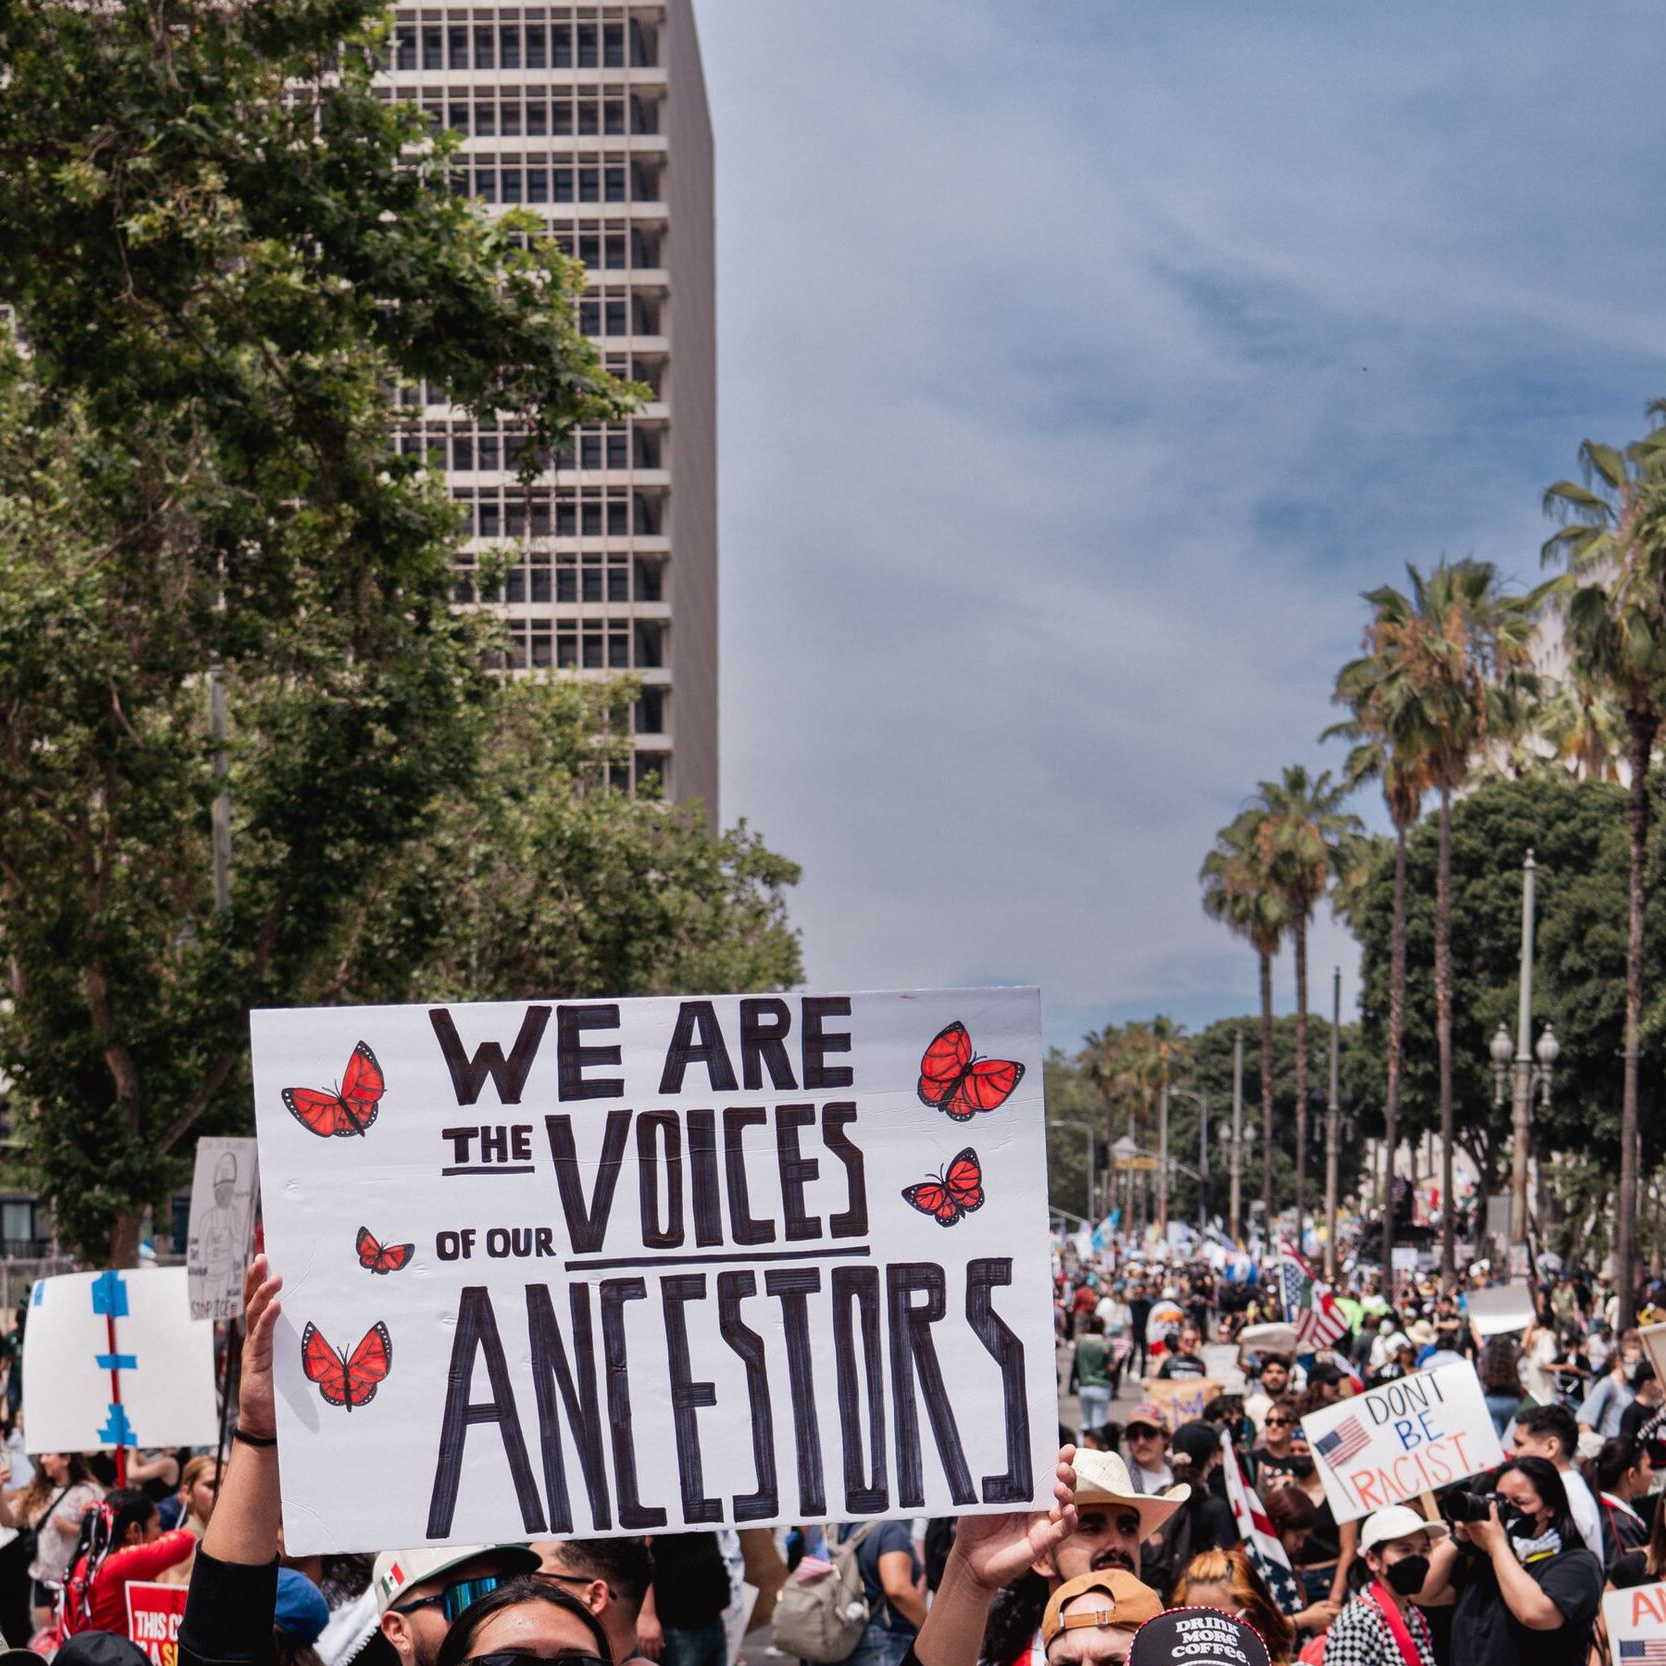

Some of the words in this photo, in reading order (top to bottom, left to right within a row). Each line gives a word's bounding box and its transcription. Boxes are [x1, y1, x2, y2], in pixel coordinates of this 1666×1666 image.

[428, 1005, 625, 1105] WE
[659, 997, 854, 1093] ARE
[442, 1124, 534, 1165] THE
[545, 1101, 868, 1253] VOICES
[435, 1229, 477, 1261] OF
[486, 1226, 555, 1258] OUR
[426, 1257, 1035, 1539] ANCESTORS
[1394, 1410, 1446, 1451] BE
[1350, 1431, 1485, 1511] RACIST.
[134, 1611, 167, 1641] THIS
